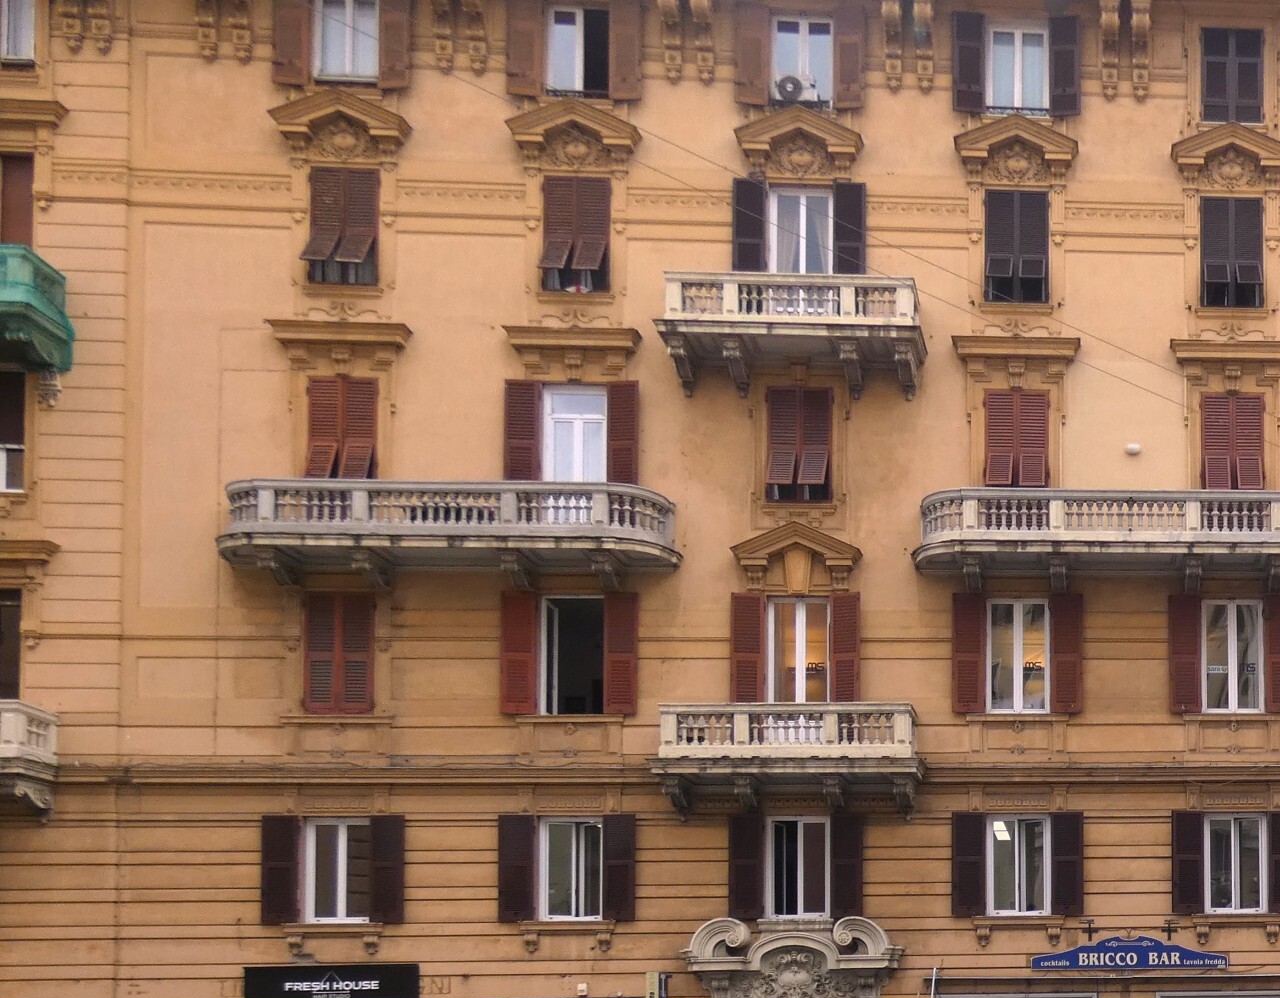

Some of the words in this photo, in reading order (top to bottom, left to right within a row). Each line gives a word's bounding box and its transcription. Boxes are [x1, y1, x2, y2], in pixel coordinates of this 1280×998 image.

[1040, 959, 1070, 967] cocktails
[1078, 952, 1138, 966] BRICCO
[1148, 952, 1181, 965] BAR
[1204, 958, 1226, 966] fredda
[283, 981, 330, 992] FRESH
[333, 980, 380, 991] HOUSE
